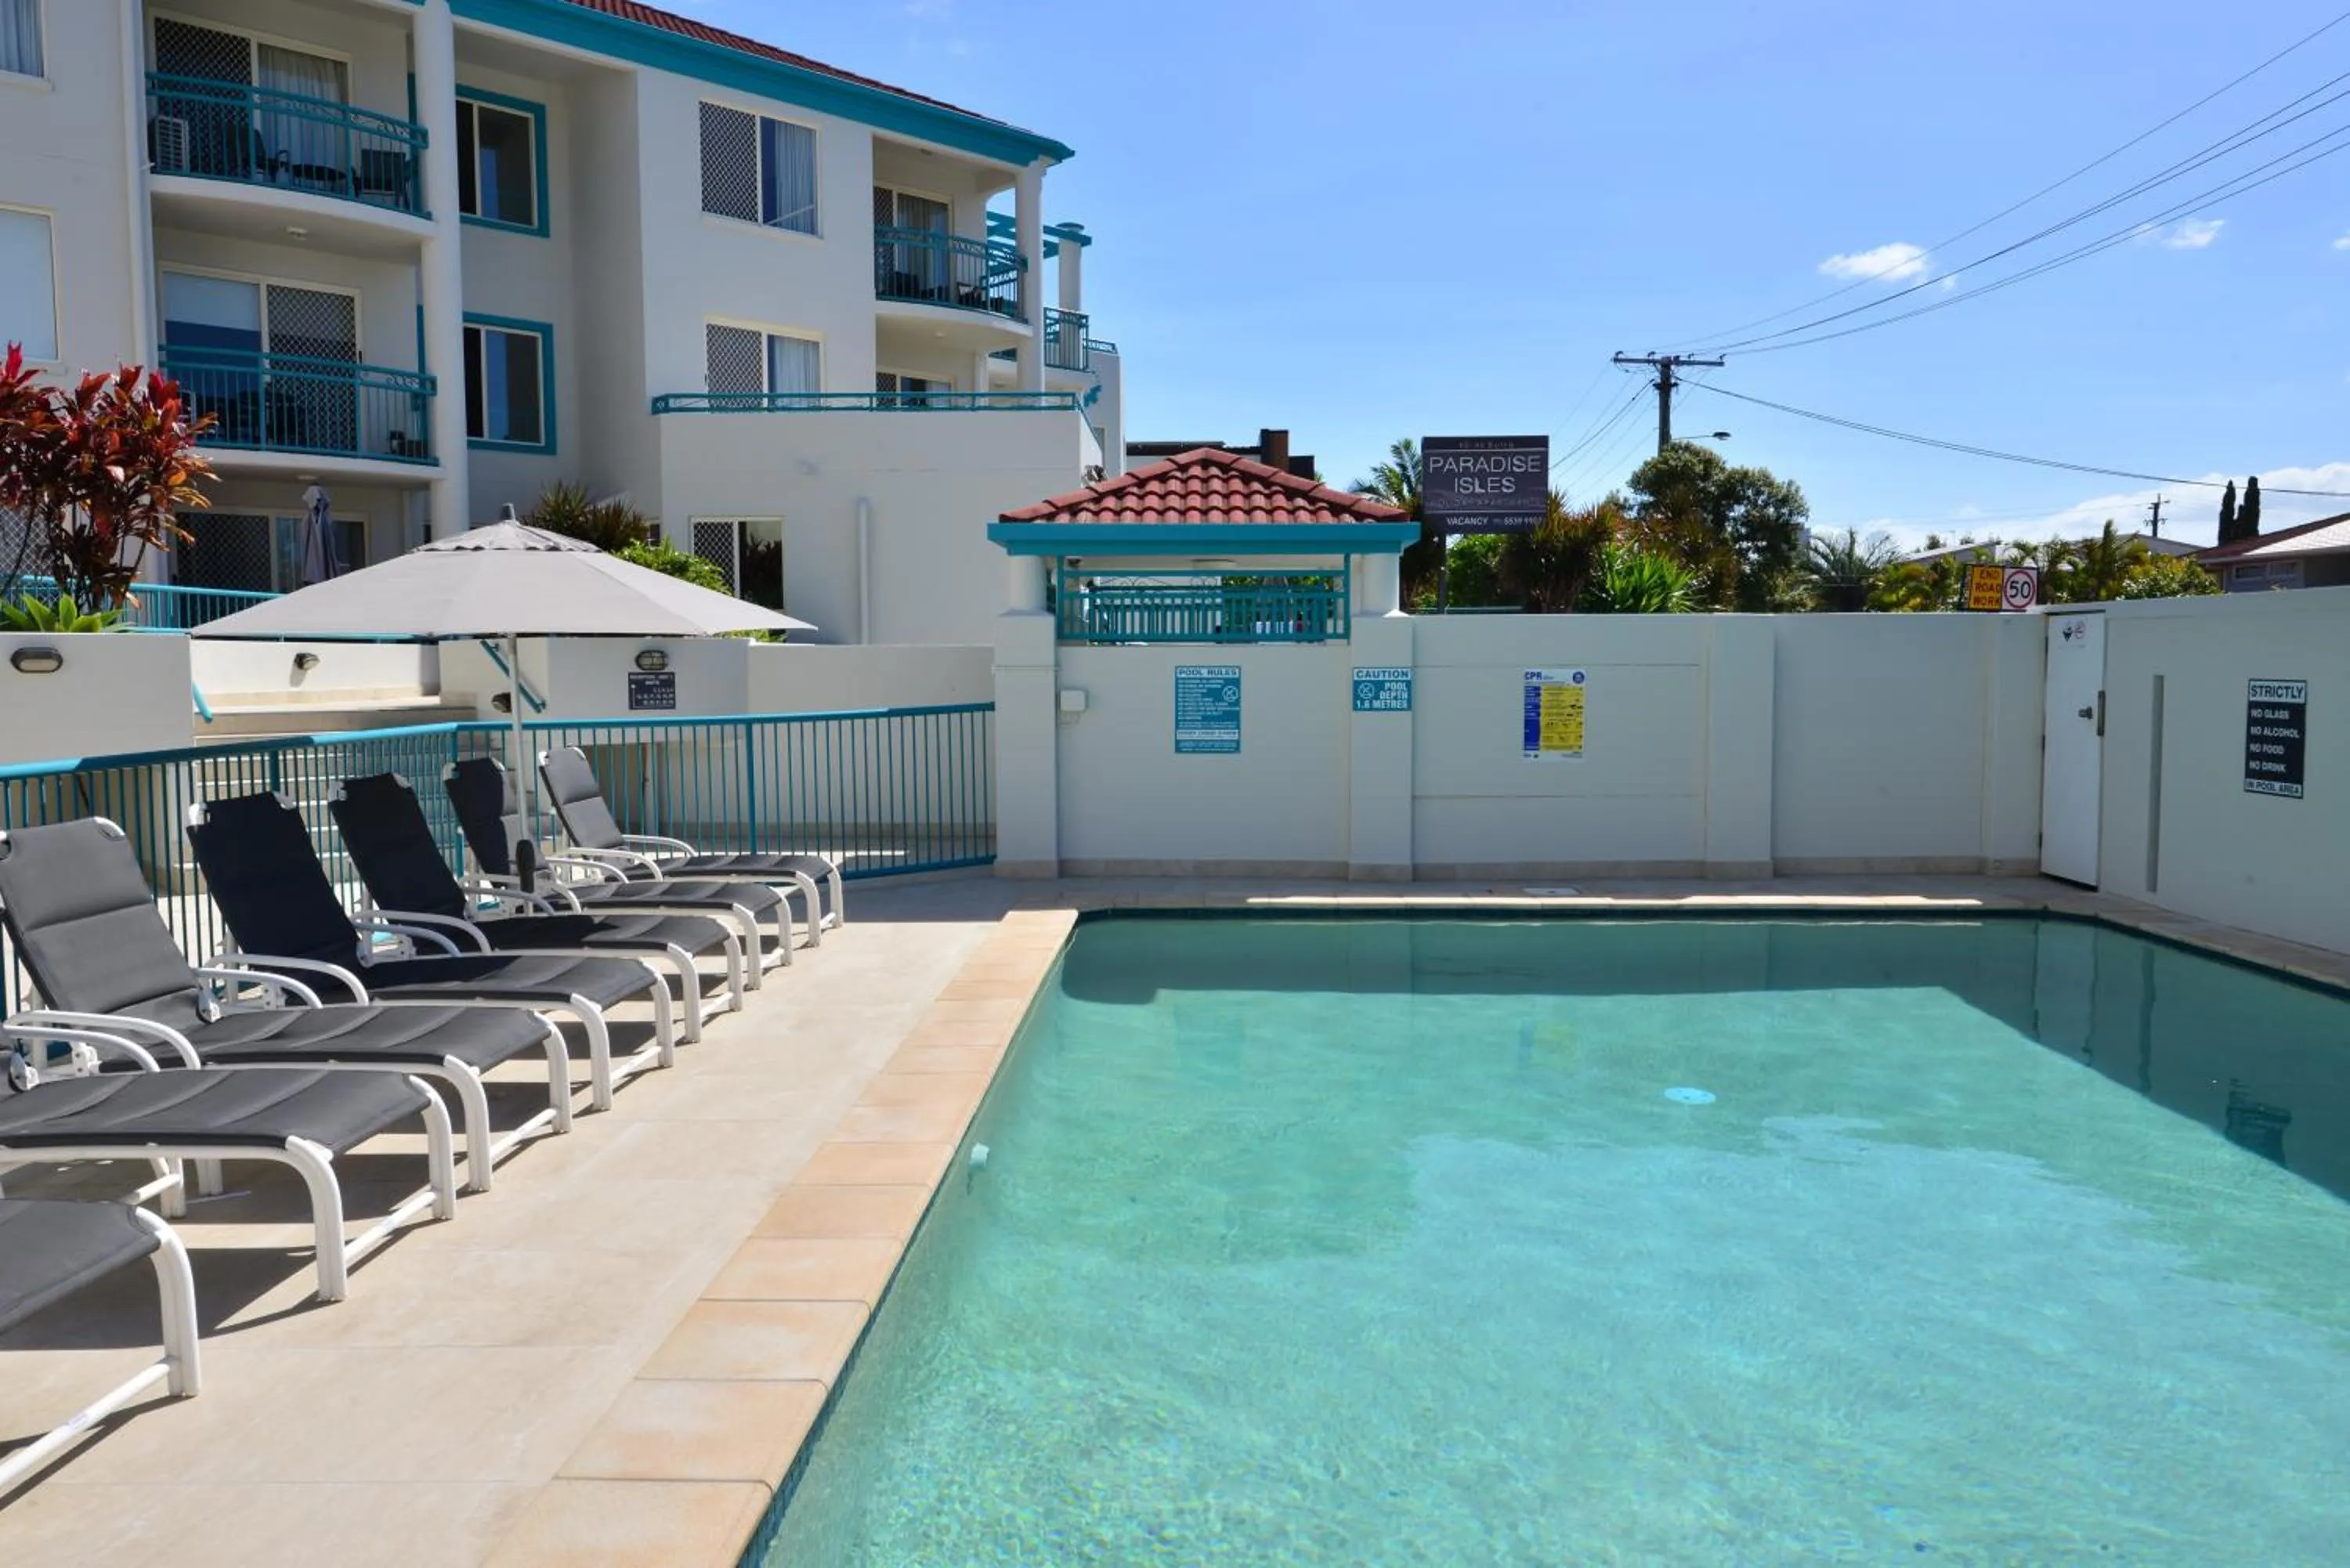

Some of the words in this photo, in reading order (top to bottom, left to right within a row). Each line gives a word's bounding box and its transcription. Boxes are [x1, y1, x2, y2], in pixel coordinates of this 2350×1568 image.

[1430, 455, 1542, 473] PARADISE
[1455, 477, 1516, 494] ISLES
[1447, 516, 1488, 526] VACANCY
[1979, 569, 2000, 580] END
[2009, 580, 2031, 598] 50
[1356, 670, 1409, 678] CAUTION
[1524, 671, 1542, 680] CPR
[1379, 690, 1408, 699] DEPTH
[2251, 685, 2304, 699] STRICTLY
[1372, 699, 1408, 709] METRES
[2251, 709, 2262, 718] NO
[2264, 709, 2290, 720] GLASS
[2251, 726, 2261, 735] NO
[2263, 727, 2300, 739] ALCOHOL
[2250, 743, 2261, 753] NO
[2262, 744, 2285, 755] FOOD
[2249, 761, 2261, 771] NO
[2262, 761, 2287, 773] DRINK
[2256, 782, 2277, 791] POOL
[2279, 784, 2301, 794] AREA
